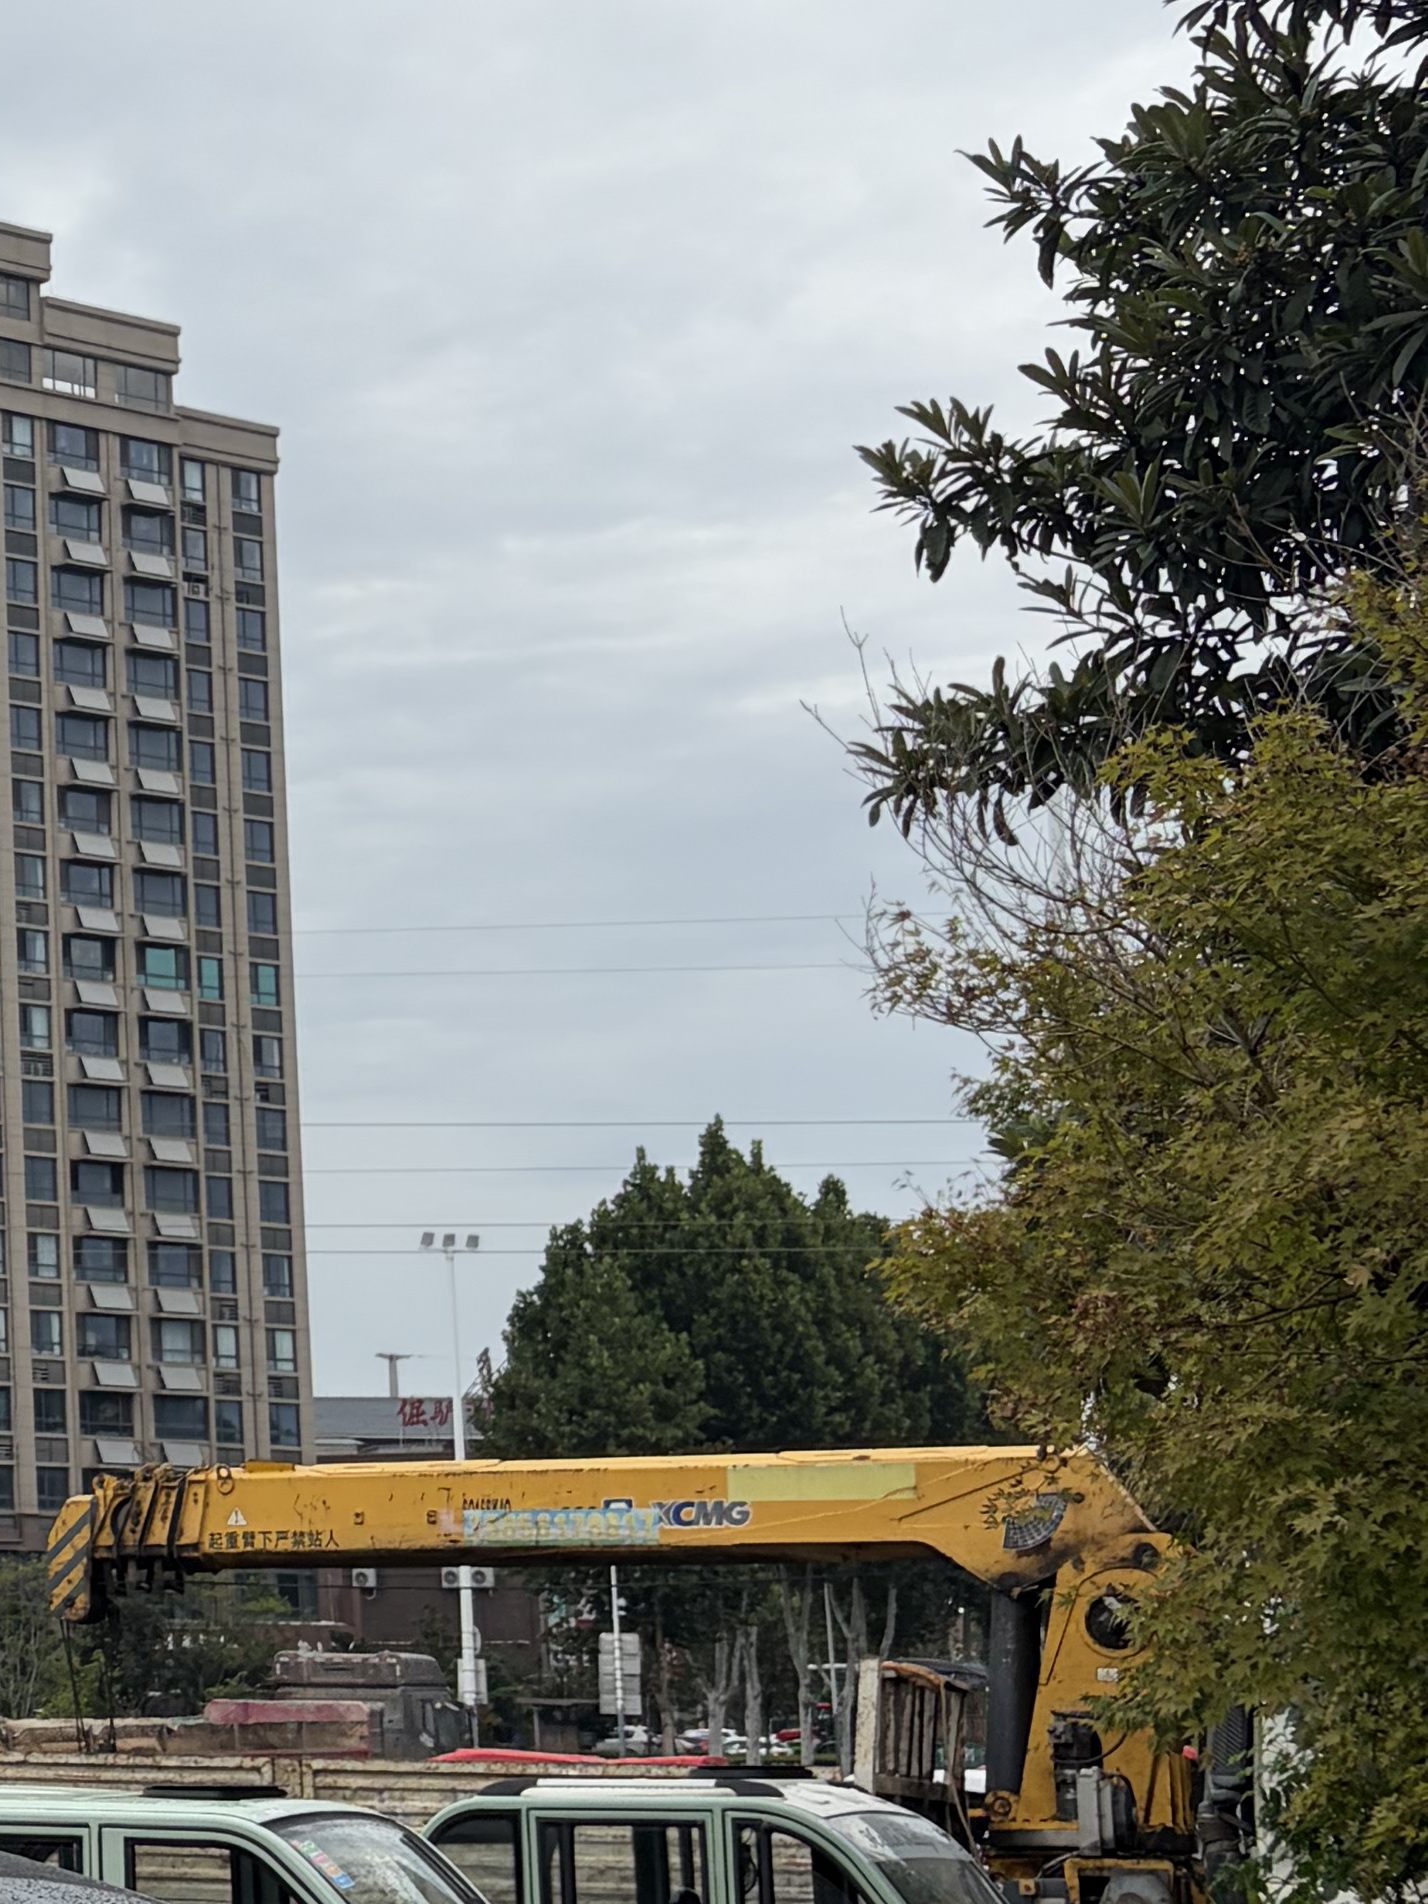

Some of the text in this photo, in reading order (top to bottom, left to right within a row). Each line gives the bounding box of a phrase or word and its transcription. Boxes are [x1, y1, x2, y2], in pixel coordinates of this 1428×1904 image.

[650, 1499, 751, 1527] XCMG
[208, 1531, 340, 1550] 起重臂下严禁站人
